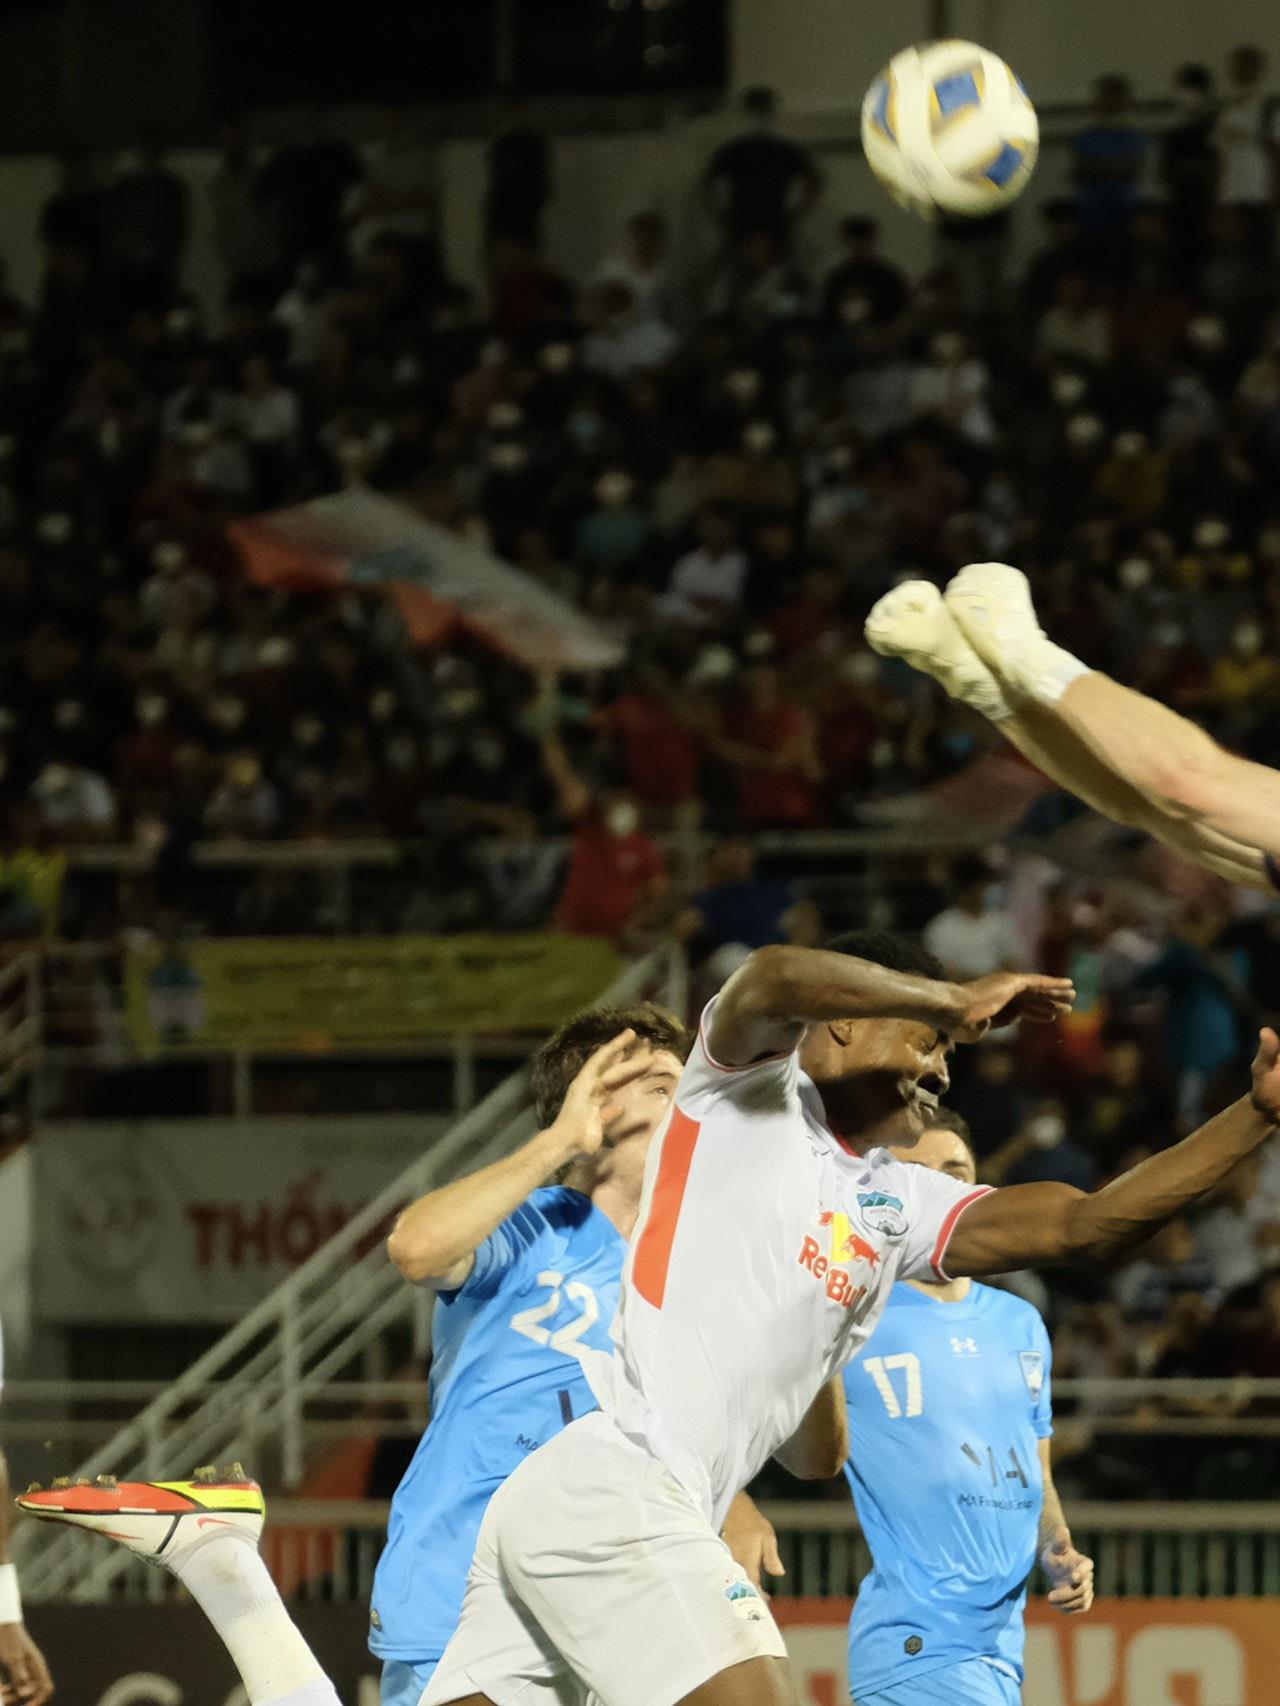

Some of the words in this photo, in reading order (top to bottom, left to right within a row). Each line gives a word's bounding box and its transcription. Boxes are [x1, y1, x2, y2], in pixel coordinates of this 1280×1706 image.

[798, 1234, 828, 1279] Re
[510, 1270, 599, 1359] 22
[863, 1352, 923, 1418] 17
